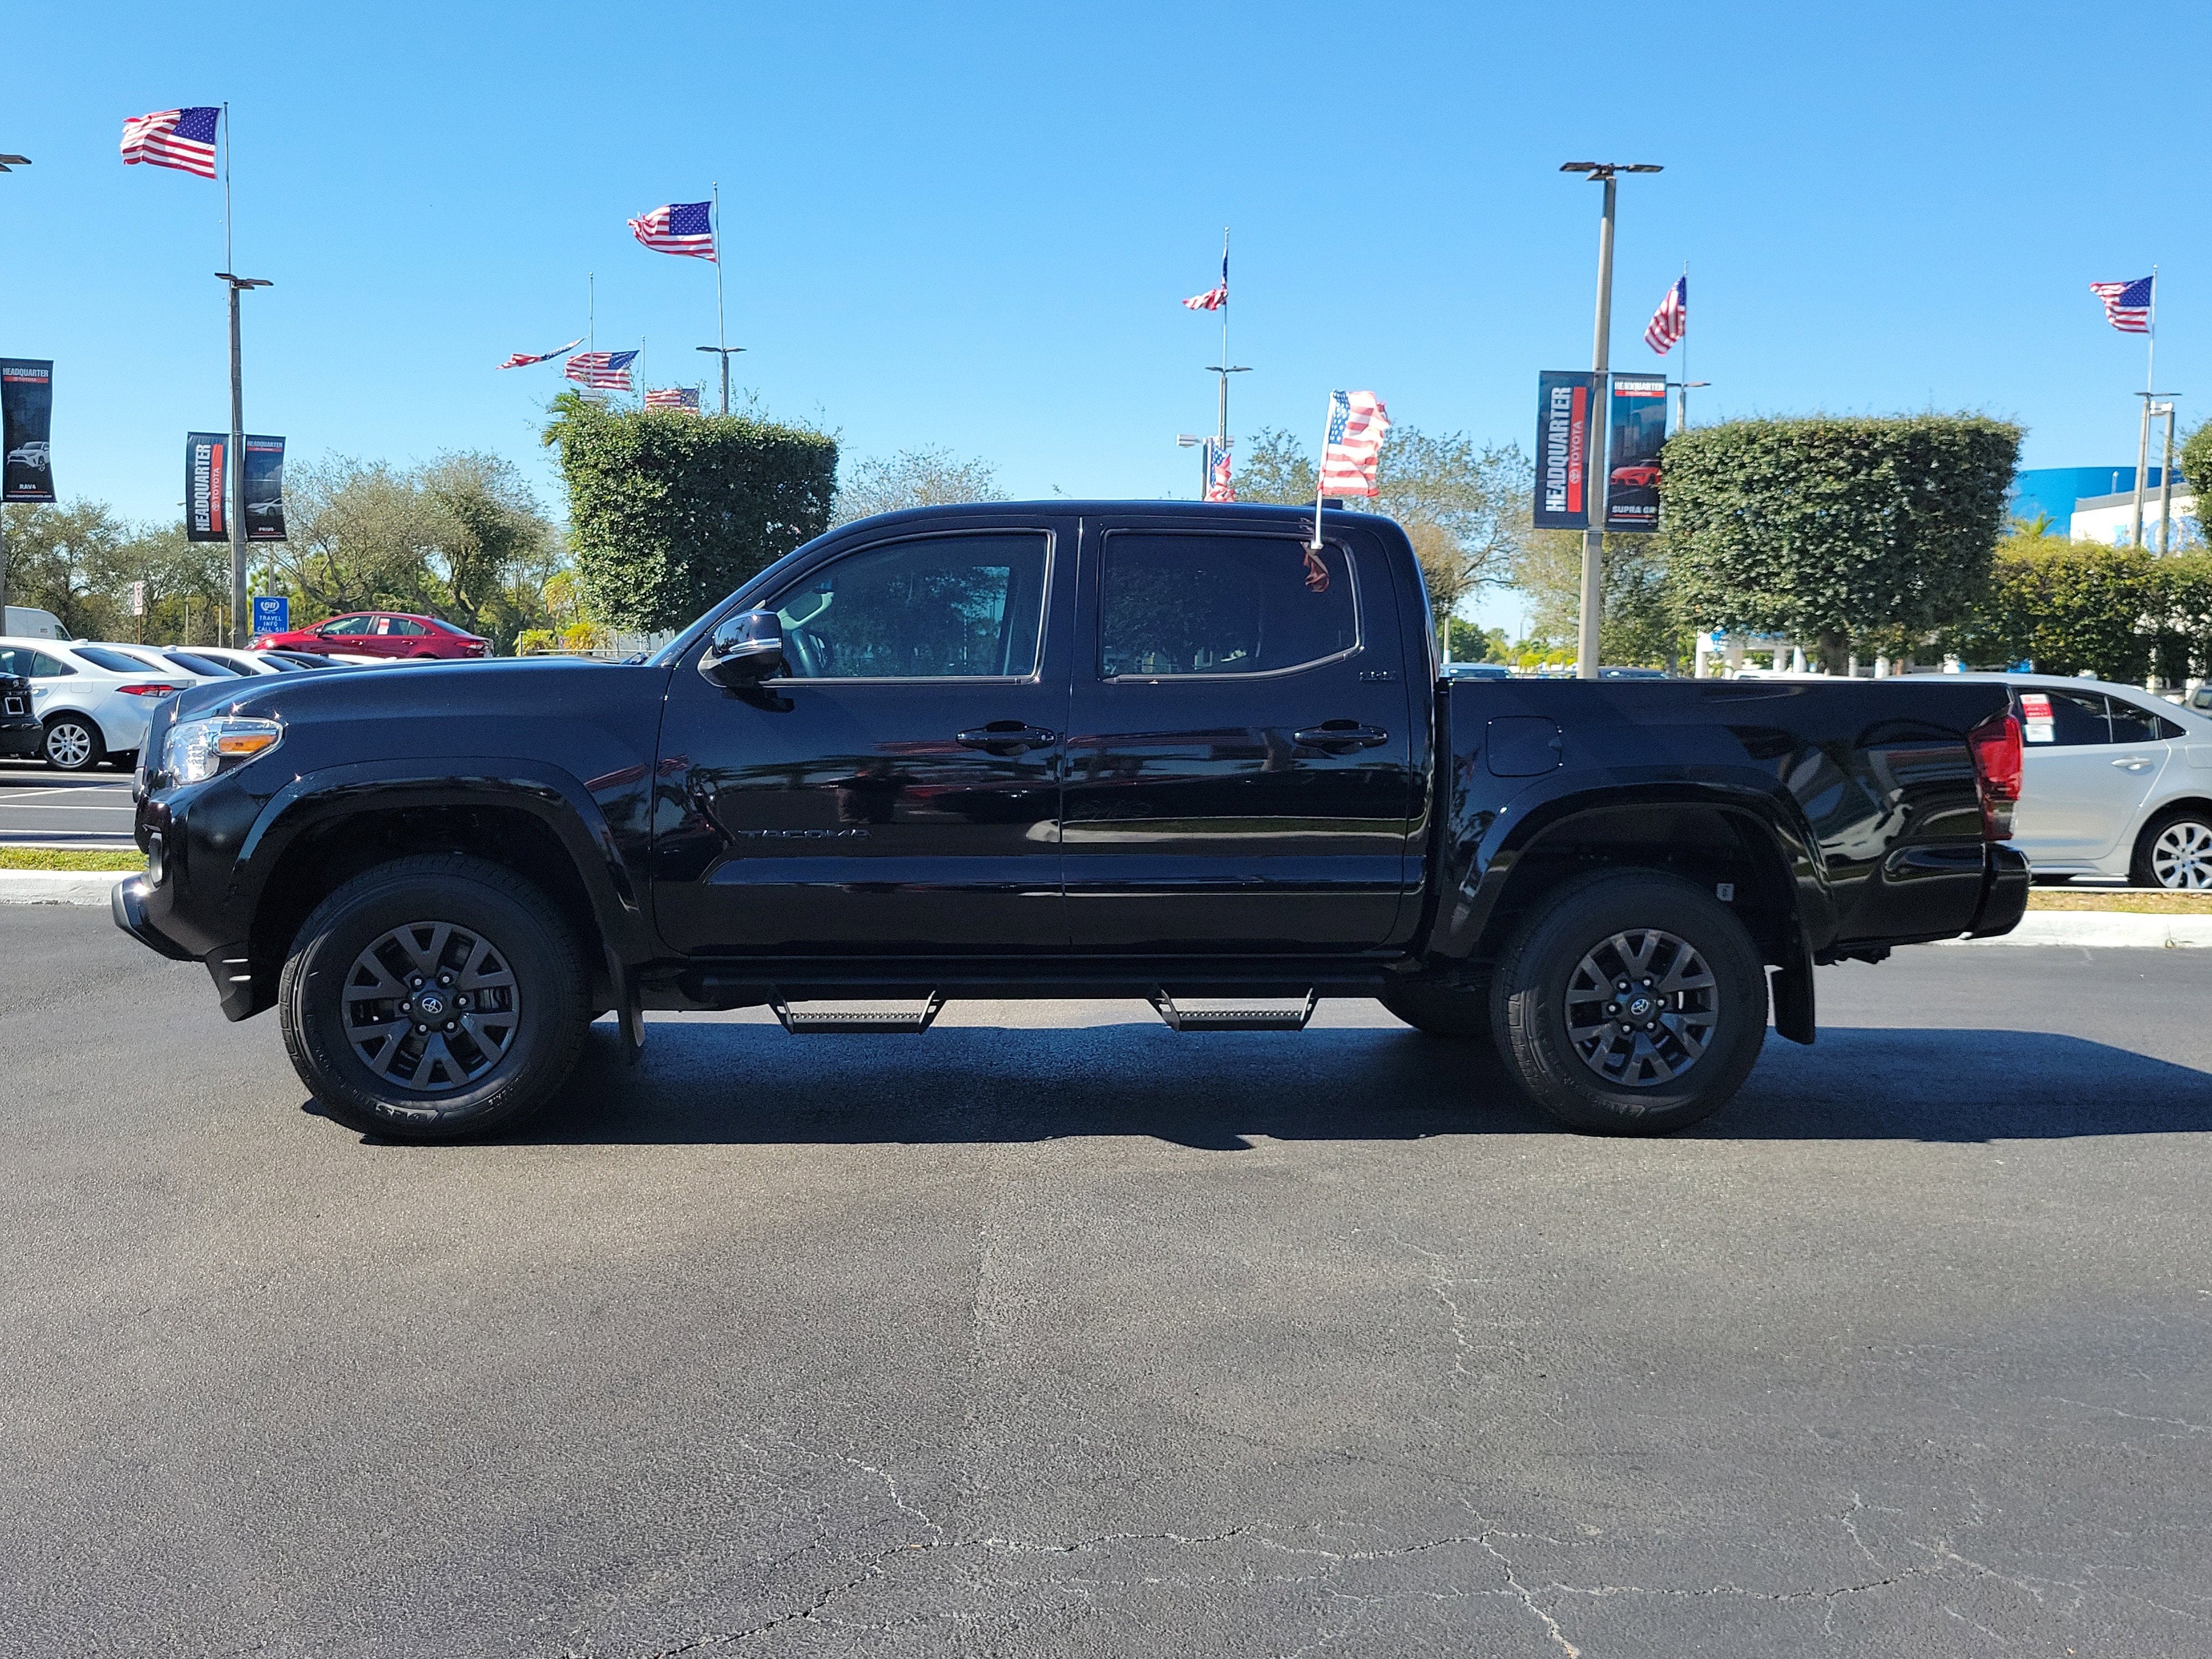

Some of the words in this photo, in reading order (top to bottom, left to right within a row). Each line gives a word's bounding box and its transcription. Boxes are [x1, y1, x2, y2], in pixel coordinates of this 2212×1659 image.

[3, 368, 49, 377] HEADQUARTER
[1545, 386, 1572, 512] HEADQUARTER
[1571, 420, 1583, 467] TOYOTA
[194, 443, 211, 532] HEADQUARTER
[212, 467, 221, 500] TOYOTA
[1612, 505, 1642, 514] SUPRA
[738, 830, 871, 838] TACOMA
